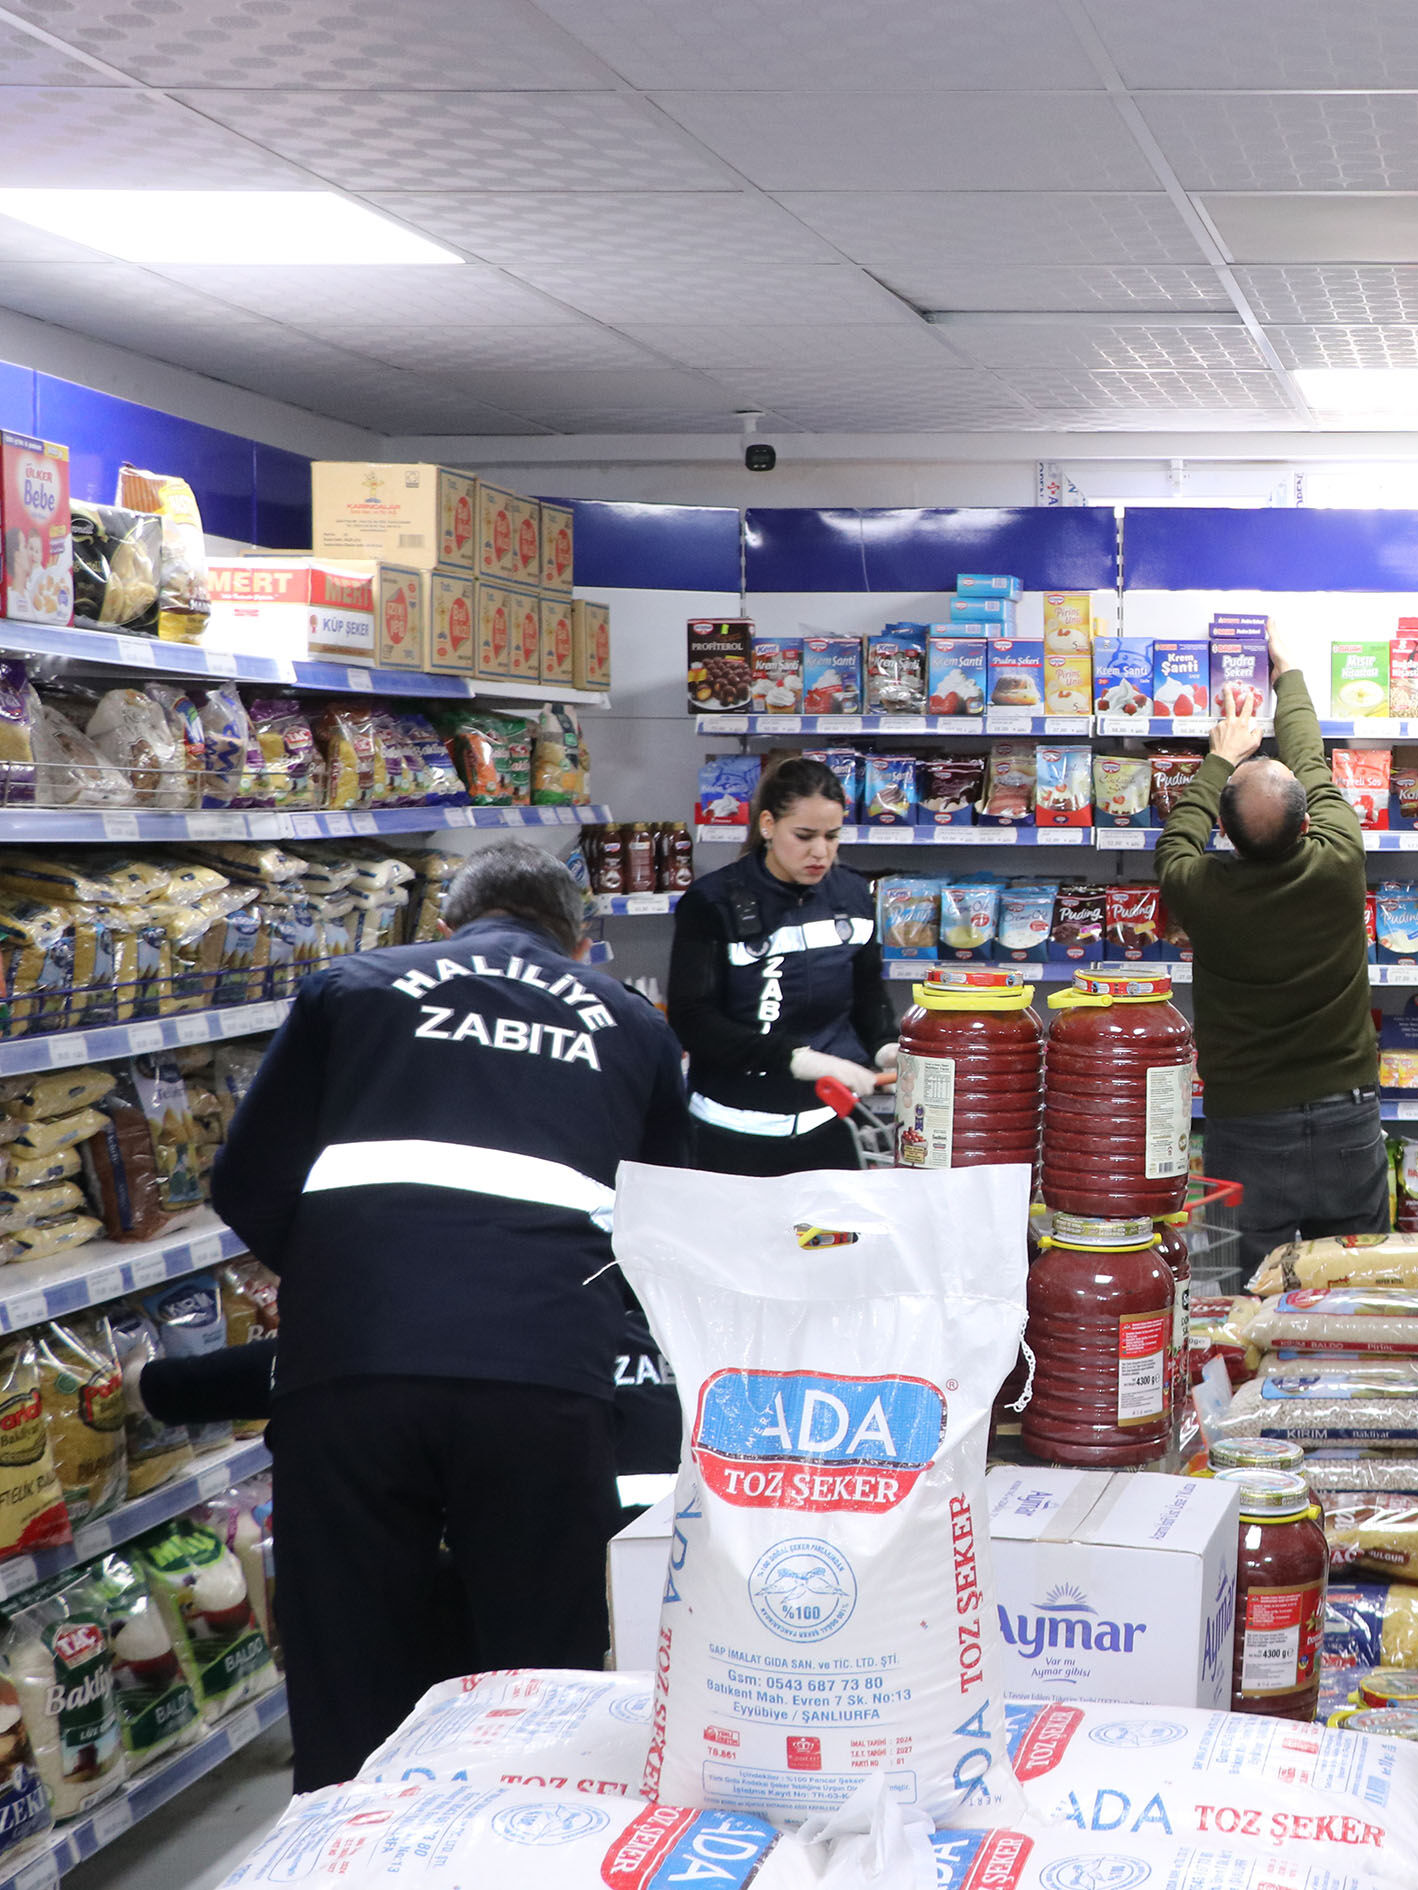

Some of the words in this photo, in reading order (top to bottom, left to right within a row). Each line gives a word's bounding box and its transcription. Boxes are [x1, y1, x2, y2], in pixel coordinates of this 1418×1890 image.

[24, 479, 55, 511] Bebe
[208, 570, 292, 594] MERT
[323, 616, 344, 633] KÜP
[346, 620, 370, 638] ŞEKER
[692, 641, 743, 651] PROFİTEROL
[1161, 660, 1199, 676] Şanti
[1168, 653, 1194, 662] Krem
[1222, 654, 1256, 668] Pudra
[1224, 667, 1254, 679] Şekeri
[1060, 907, 1101, 921] Puding
[1112, 904, 1153, 919] Puding
[392, 955, 618, 1032] HALİLİYE
[415, 1005, 602, 1072] ZABITA
[1311, 1341, 1344, 1350] BALDO
[1136, 1375, 1151, 1387] 4300
[762, 1389, 897, 1457] ADA
[1287, 1429, 1328, 1439] KIRIM
[1352, 1430, 1391, 1439] Bakliyat
[724, 1468, 785, 1498] TOZ
[792, 1473, 899, 1506] ŞEKER
[949, 1491, 984, 1616] ŞEKER
[782, 1605, 821, 1620] %100
[657, 1626, 673, 1697] TOZ
[728, 1648, 762, 1664] İMALAT
[764, 1655, 788, 1668] GIDA
[791, 1659, 815, 1670] SAN.
[818, 1661, 830, 1670] ve
[834, 1658, 853, 1669] TİC.
[856, 1656, 878, 1668] LTD.
[880, 1652, 900, 1668] ŞTİ.
[958, 1616, 984, 1694] TOZ
[1046, 1656, 1062, 1666] Var
[1262, 1648, 1282, 1659] 4300
[728, 1669, 762, 1687] Gsm:
[766, 1677, 803, 1691] 0543
[808, 1679, 836, 1691] 687
[841, 1679, 859, 1691] 73
[865, 1676, 883, 1689] 80
[1031, 1666, 1063, 1679] Aymar
[1065, 1666, 1091, 1678] gibisi
[706, 1678, 753, 1701] Batıkent
[757, 1690, 788, 1705] Mah.
[792, 1695, 830, 1707] Evren
[835, 1695, 842, 1706] 7
[847, 1694, 868, 1706] Sk.
[872, 1688, 912, 1705] No:13
[733, 1701, 788, 1721] Eyyübiye
[792, 1710, 798, 1721] /
[801, 1708, 881, 1724] ŞANLIURFA
[1026, 1740, 1057, 1771] TOZ
[1064, 1788, 1174, 1835] ADA
[1194, 1804, 1263, 1836] TOZ
[1269, 1812, 1386, 1849] ŞEKER
[610, 1824, 666, 1875] ŞEKER
[667, 1821, 767, 1882] ADA
[982, 1838, 1025, 1887] ŞEKER
